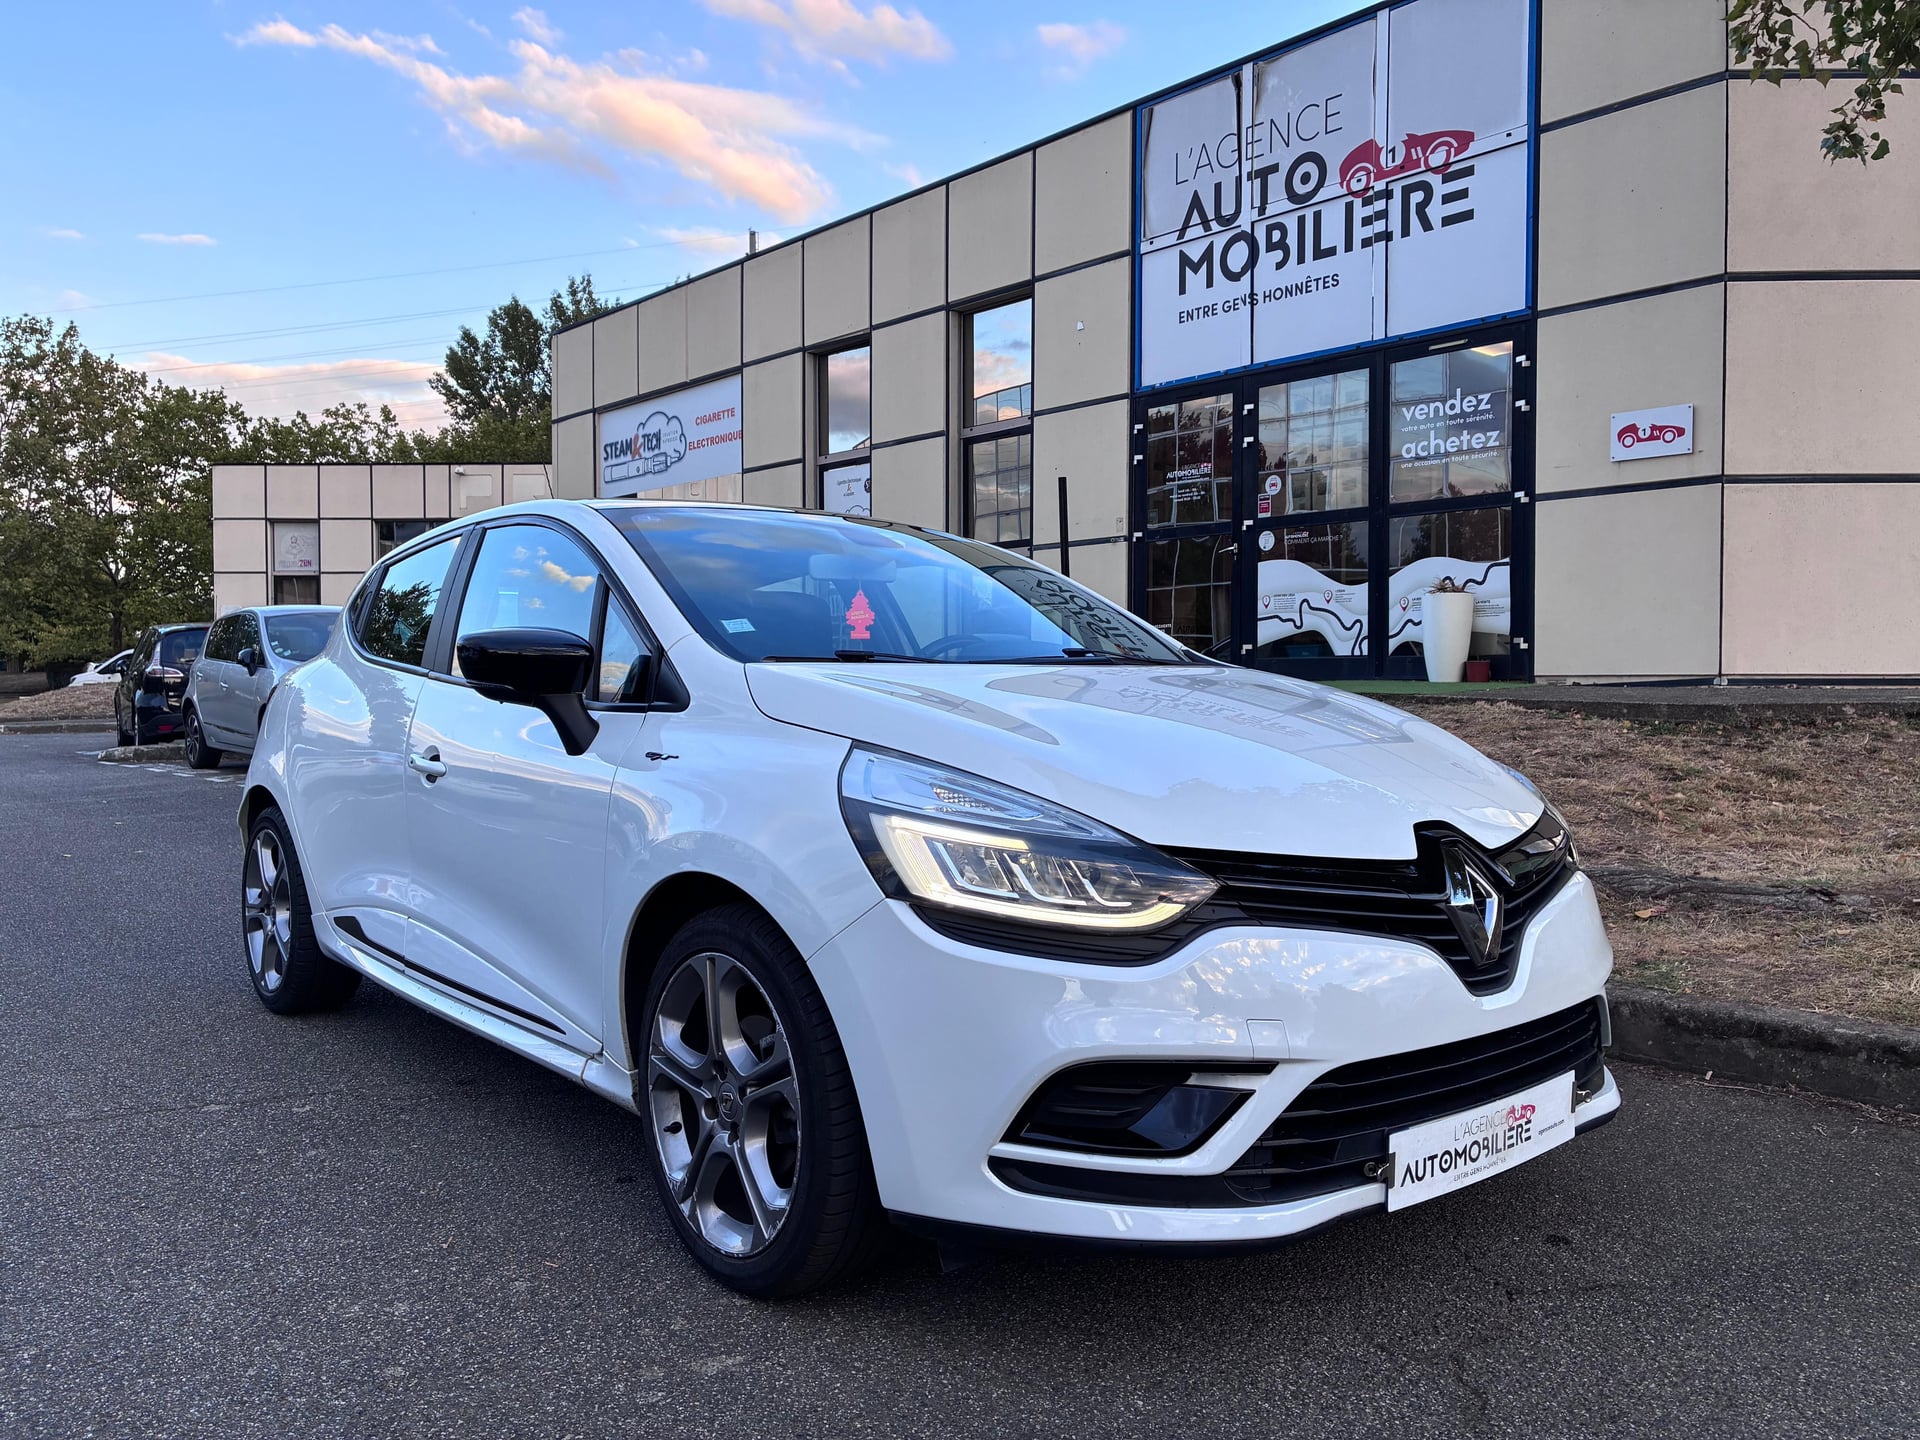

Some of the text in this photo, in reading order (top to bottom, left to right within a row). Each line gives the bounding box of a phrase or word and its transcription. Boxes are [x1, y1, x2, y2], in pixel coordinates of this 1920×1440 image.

[1175, 93, 1343, 186] L'AGENCE
[1176, 151, 1328, 241] AUTO
[1178, 273, 1340, 324] ENTRE GENS HONNÊTES
[695, 407, 736, 426] CIGARETTE
[1401, 387, 1492, 421] vendez
[1401, 424, 1418, 432] votre
[1419, 422, 1435, 430] auto
[1446, 417, 1465, 426] toute
[688, 430, 743, 451] ELECTRONIQUE
[1401, 430, 1500, 459] achetez
[1413, 458, 1441, 467] occasion
[1451, 453, 1470, 462] toute
[1454, 1108, 1507, 1142] L'AGENCE
[1470, 1167, 1483, 1176] GENS
